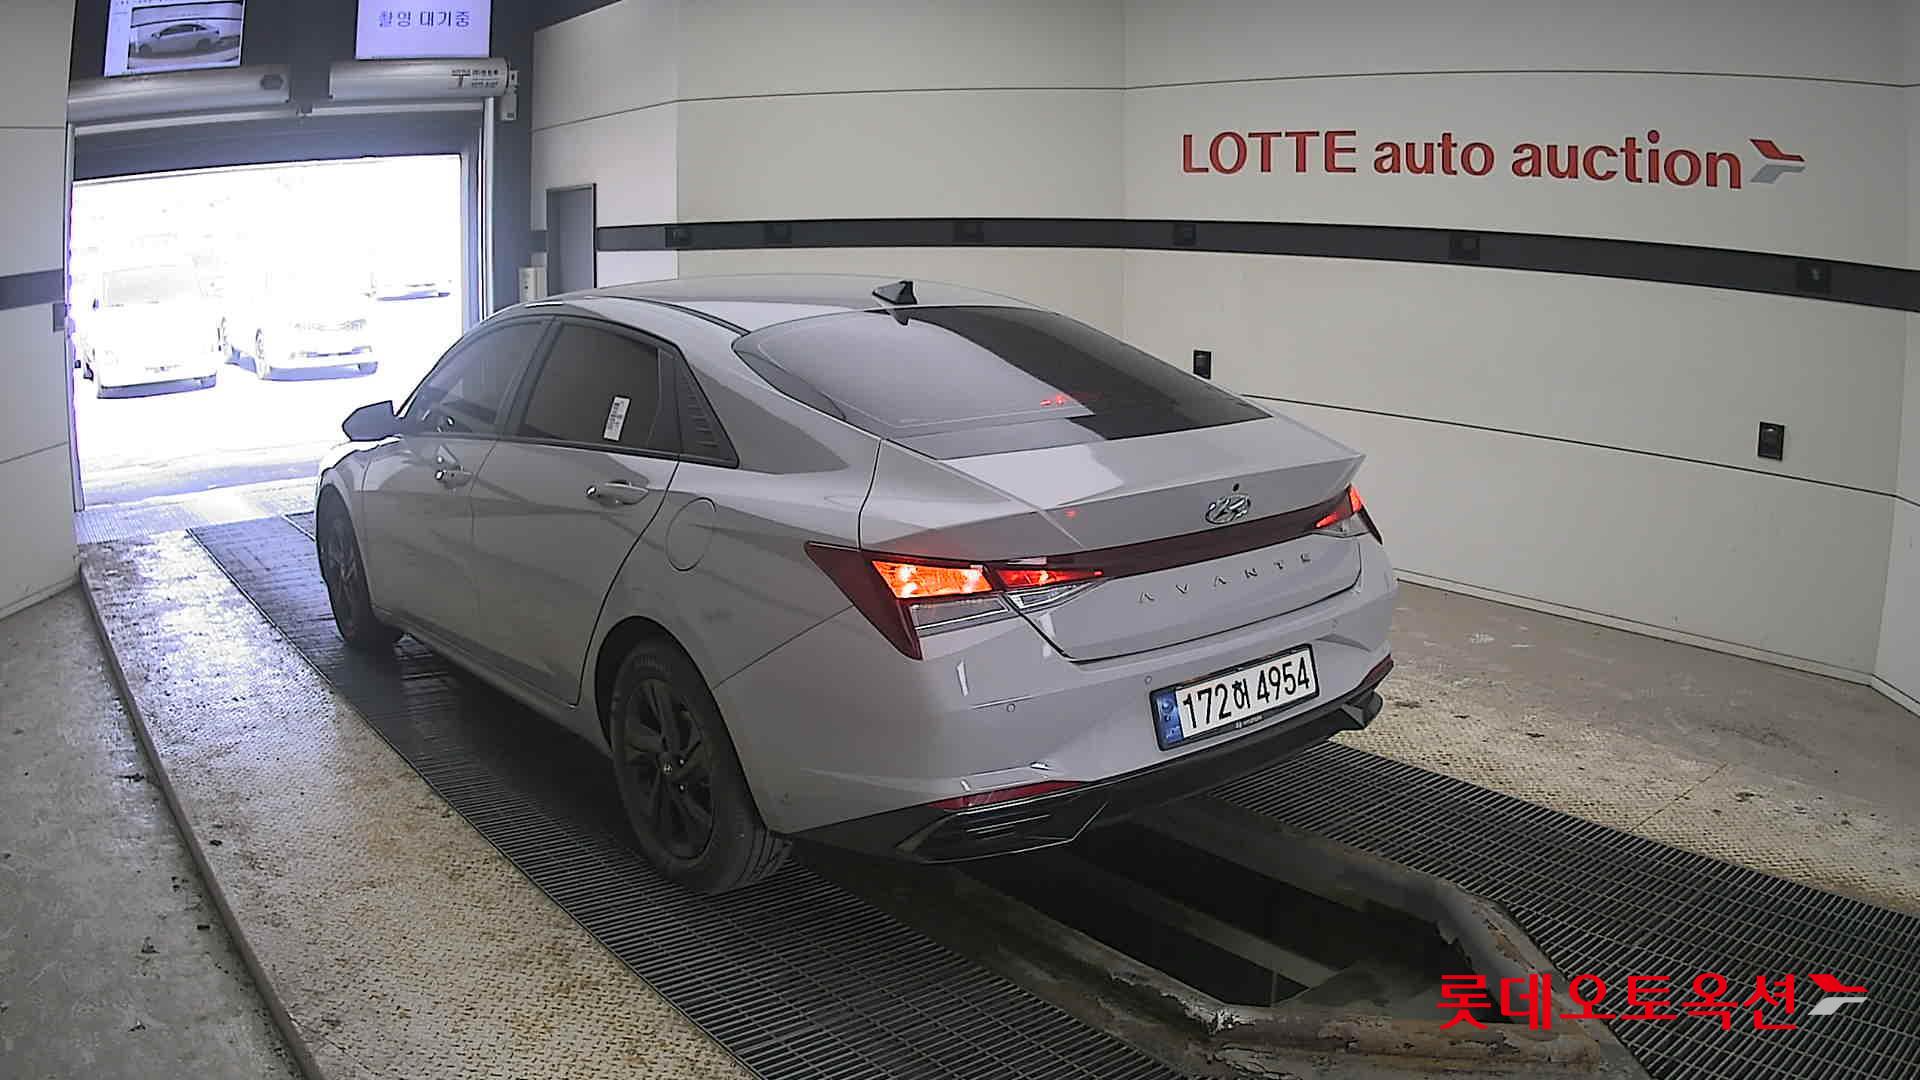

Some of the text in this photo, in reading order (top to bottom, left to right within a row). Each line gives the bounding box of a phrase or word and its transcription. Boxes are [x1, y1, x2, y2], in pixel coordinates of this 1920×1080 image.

[420, 9, 470, 28] 대기중
[1182, 129, 1742, 189] LOTTE auto auction
[1138, 552, 1312, 604] AVANTE
[1183, 656, 1310, 729] 172허 4954
